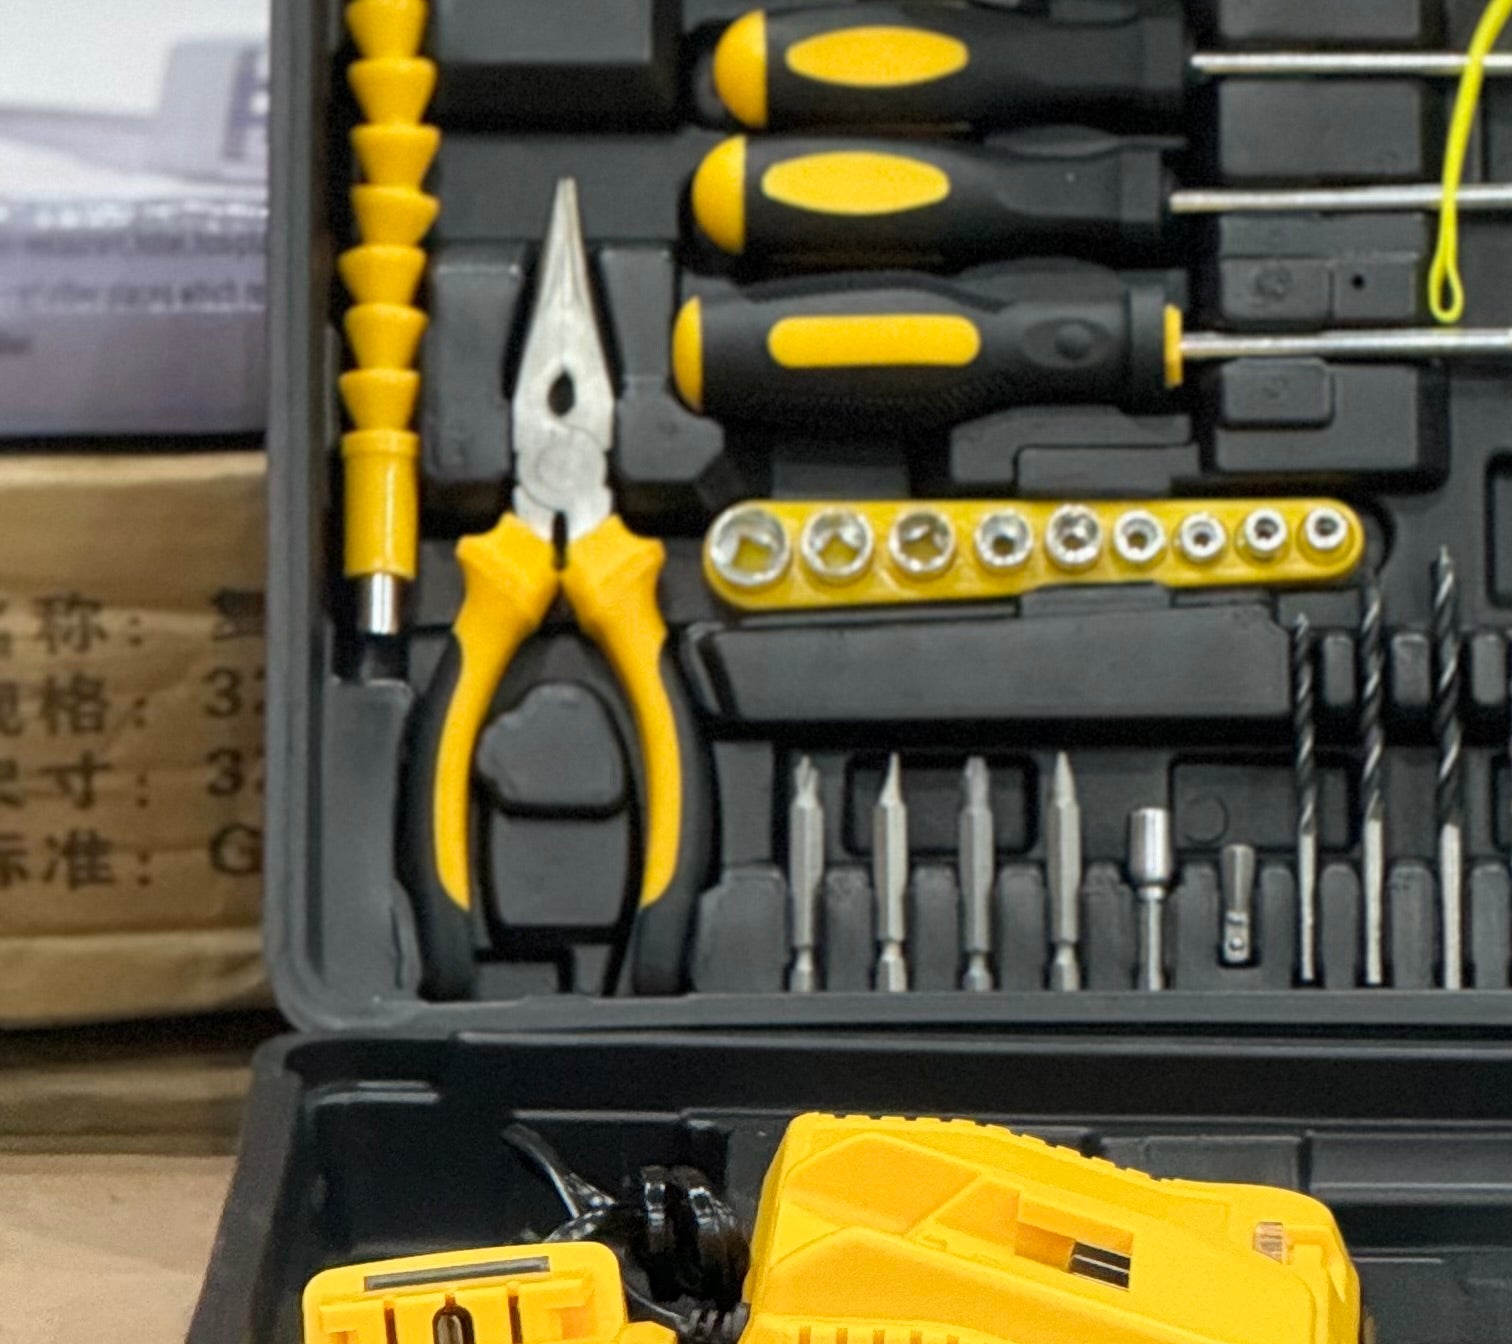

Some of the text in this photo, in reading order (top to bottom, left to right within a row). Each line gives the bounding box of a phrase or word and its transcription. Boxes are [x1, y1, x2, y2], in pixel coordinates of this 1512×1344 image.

[0, 592, 143, 656] 称：
[202, 665, 267, 719] 3
[205, 745, 267, 798] 3
